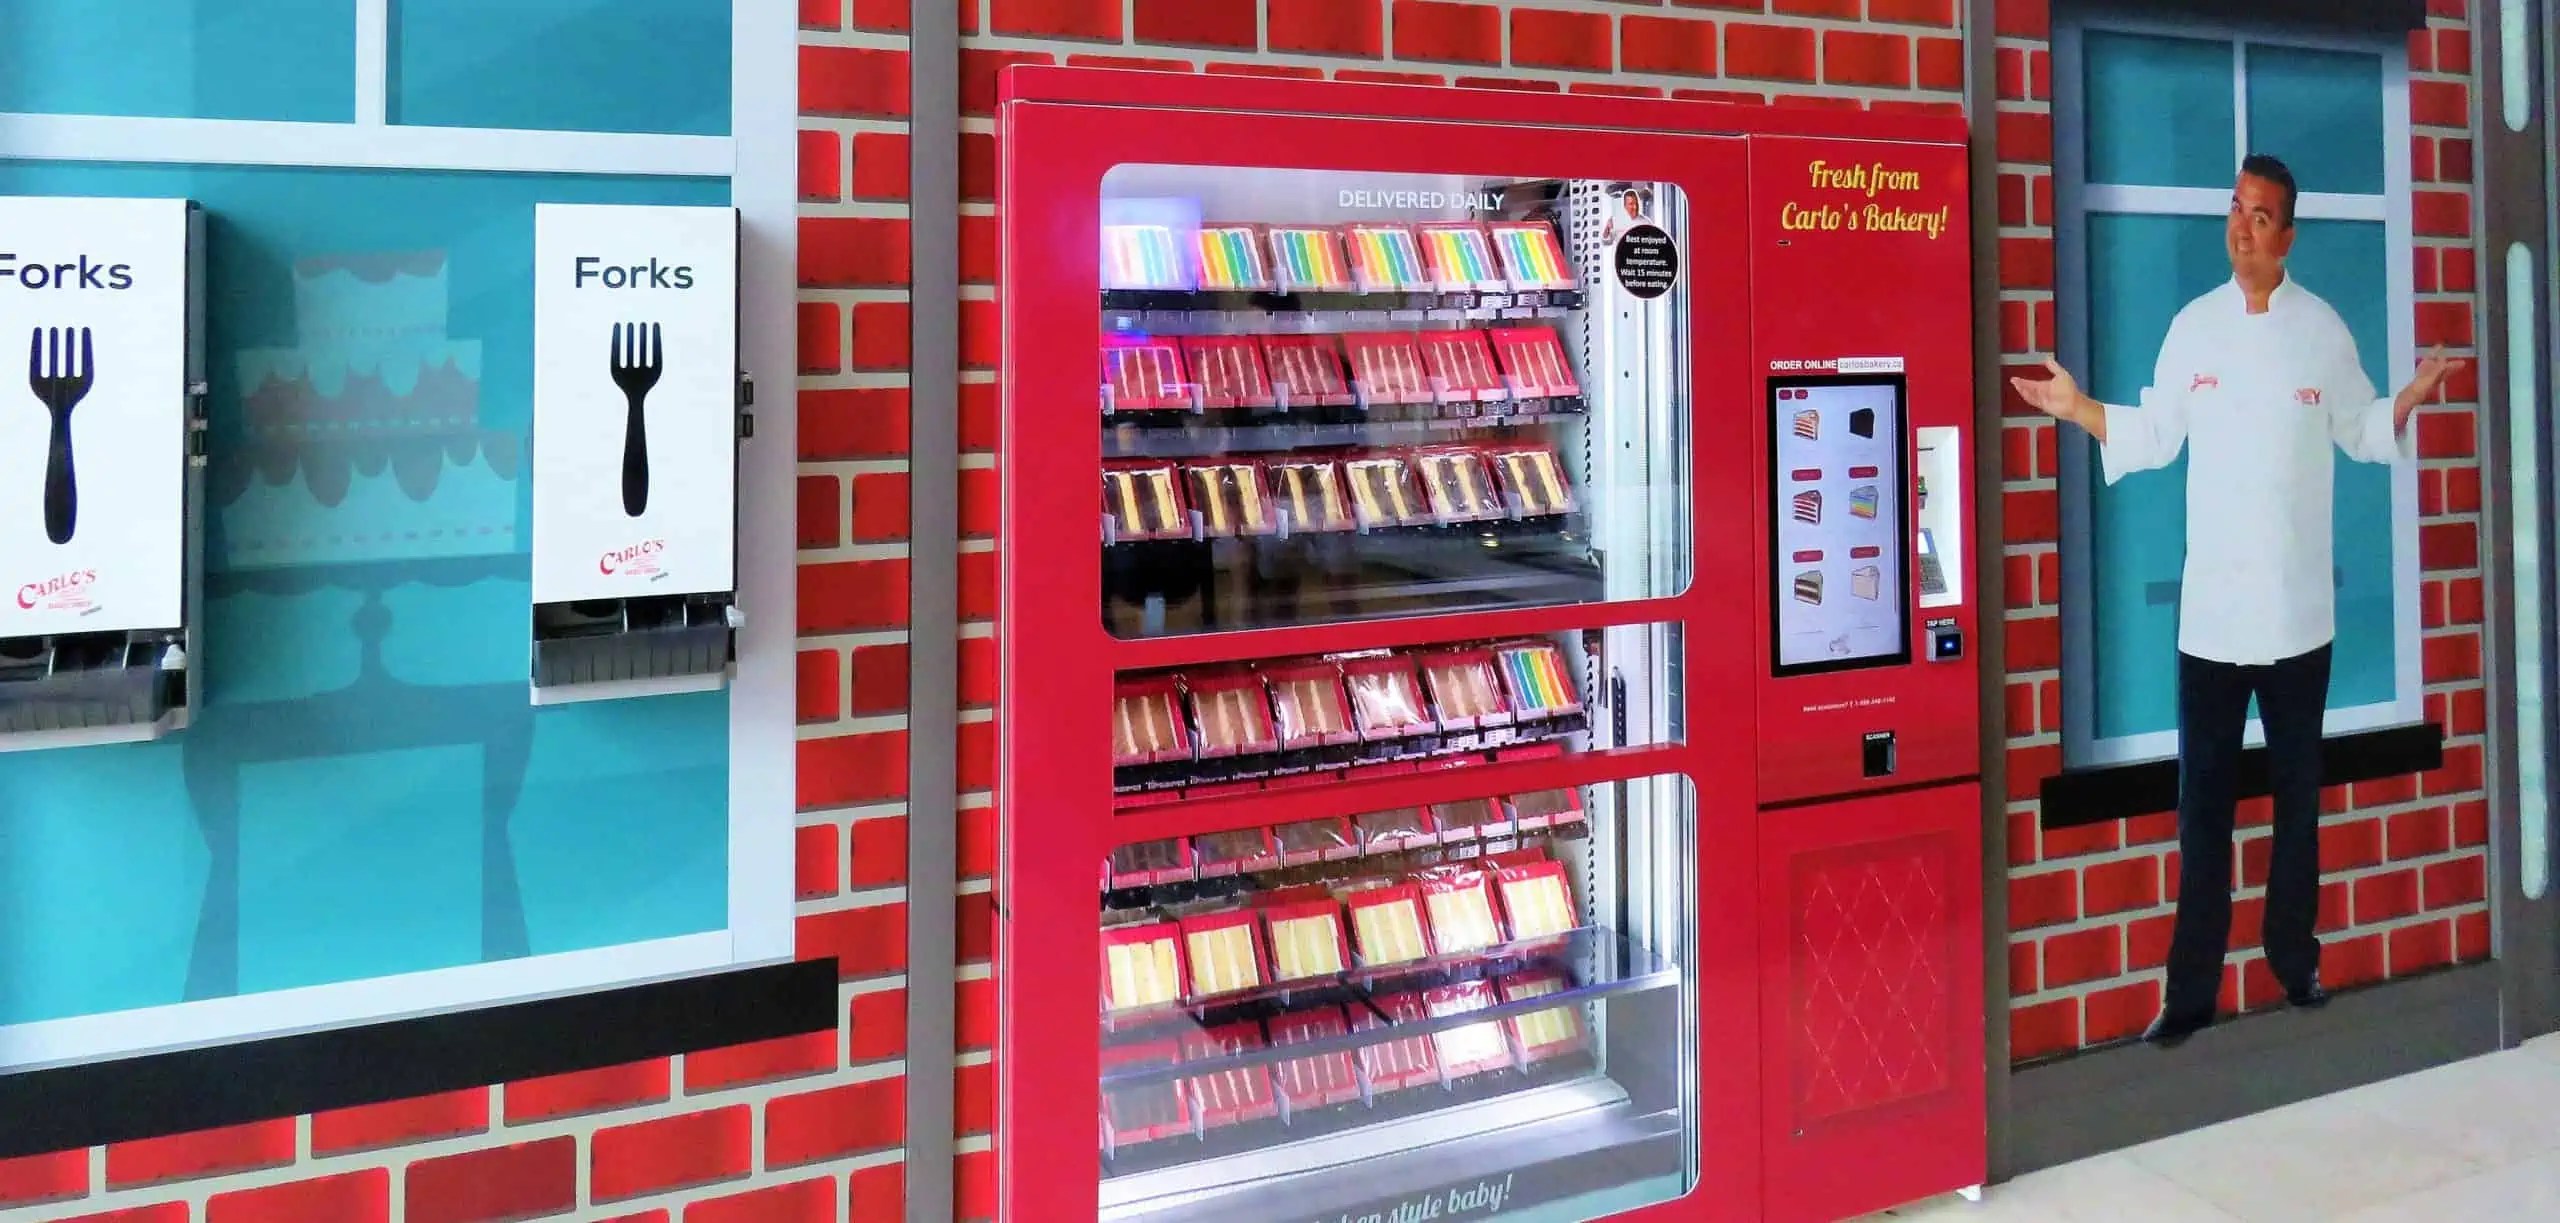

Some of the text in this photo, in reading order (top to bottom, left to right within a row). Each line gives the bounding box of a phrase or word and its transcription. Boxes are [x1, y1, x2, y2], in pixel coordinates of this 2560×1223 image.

[1809, 160, 1920, 198] Fresh from
[1338, 190, 1504, 211] DELIVERED DAILY
[1781, 201, 1948, 240] Carlo's Bakery!
[1625, 235, 1667, 245] Best enjoyed
[1633, 247, 1640, 255] at
[575, 256, 694, 289] Forks
[1620, 268, 1672, 277] Wait 15 minutes
[1625, 280, 1646, 288] before
[1770, 360, 1802, 370] ORDER
[1804, 359, 1837, 369] ONLINE
[1387, 1173, 1512, 1223] style baby!
